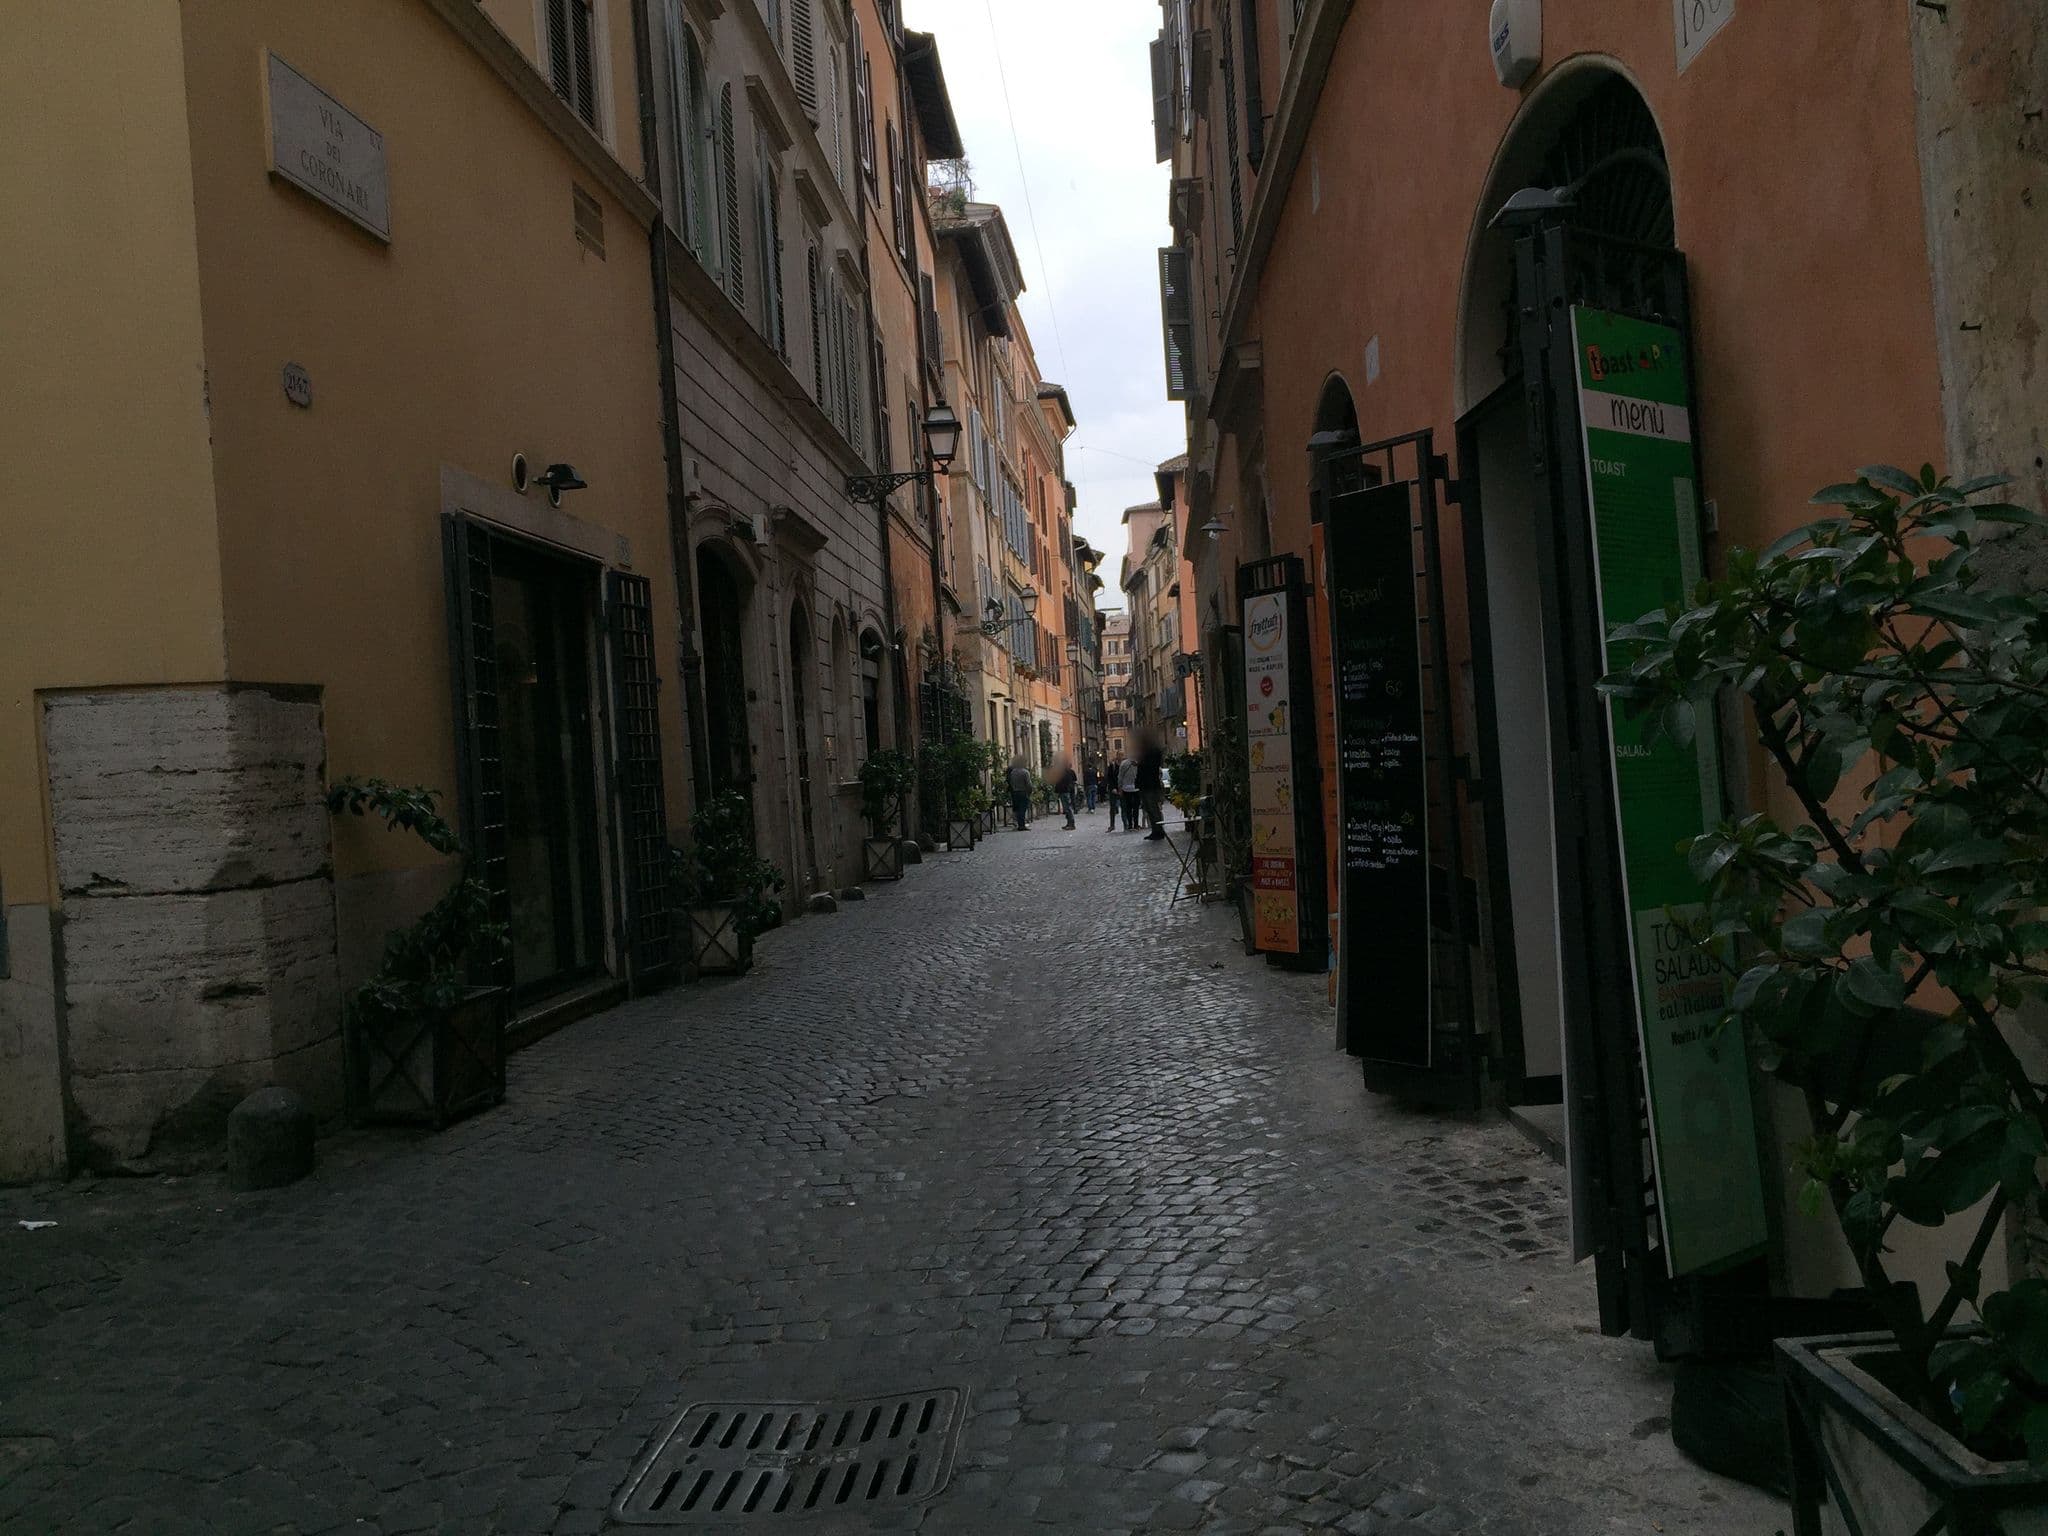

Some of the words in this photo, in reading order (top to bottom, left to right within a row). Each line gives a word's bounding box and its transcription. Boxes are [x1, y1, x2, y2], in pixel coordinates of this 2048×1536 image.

[319, 104, 345, 142] VIA
[326, 140, 342, 164] DEI
[301, 149, 369, 212] CORONARI
[1611, 399, 1665, 435] menù
[1592, 459, 1626, 477] TOAST
